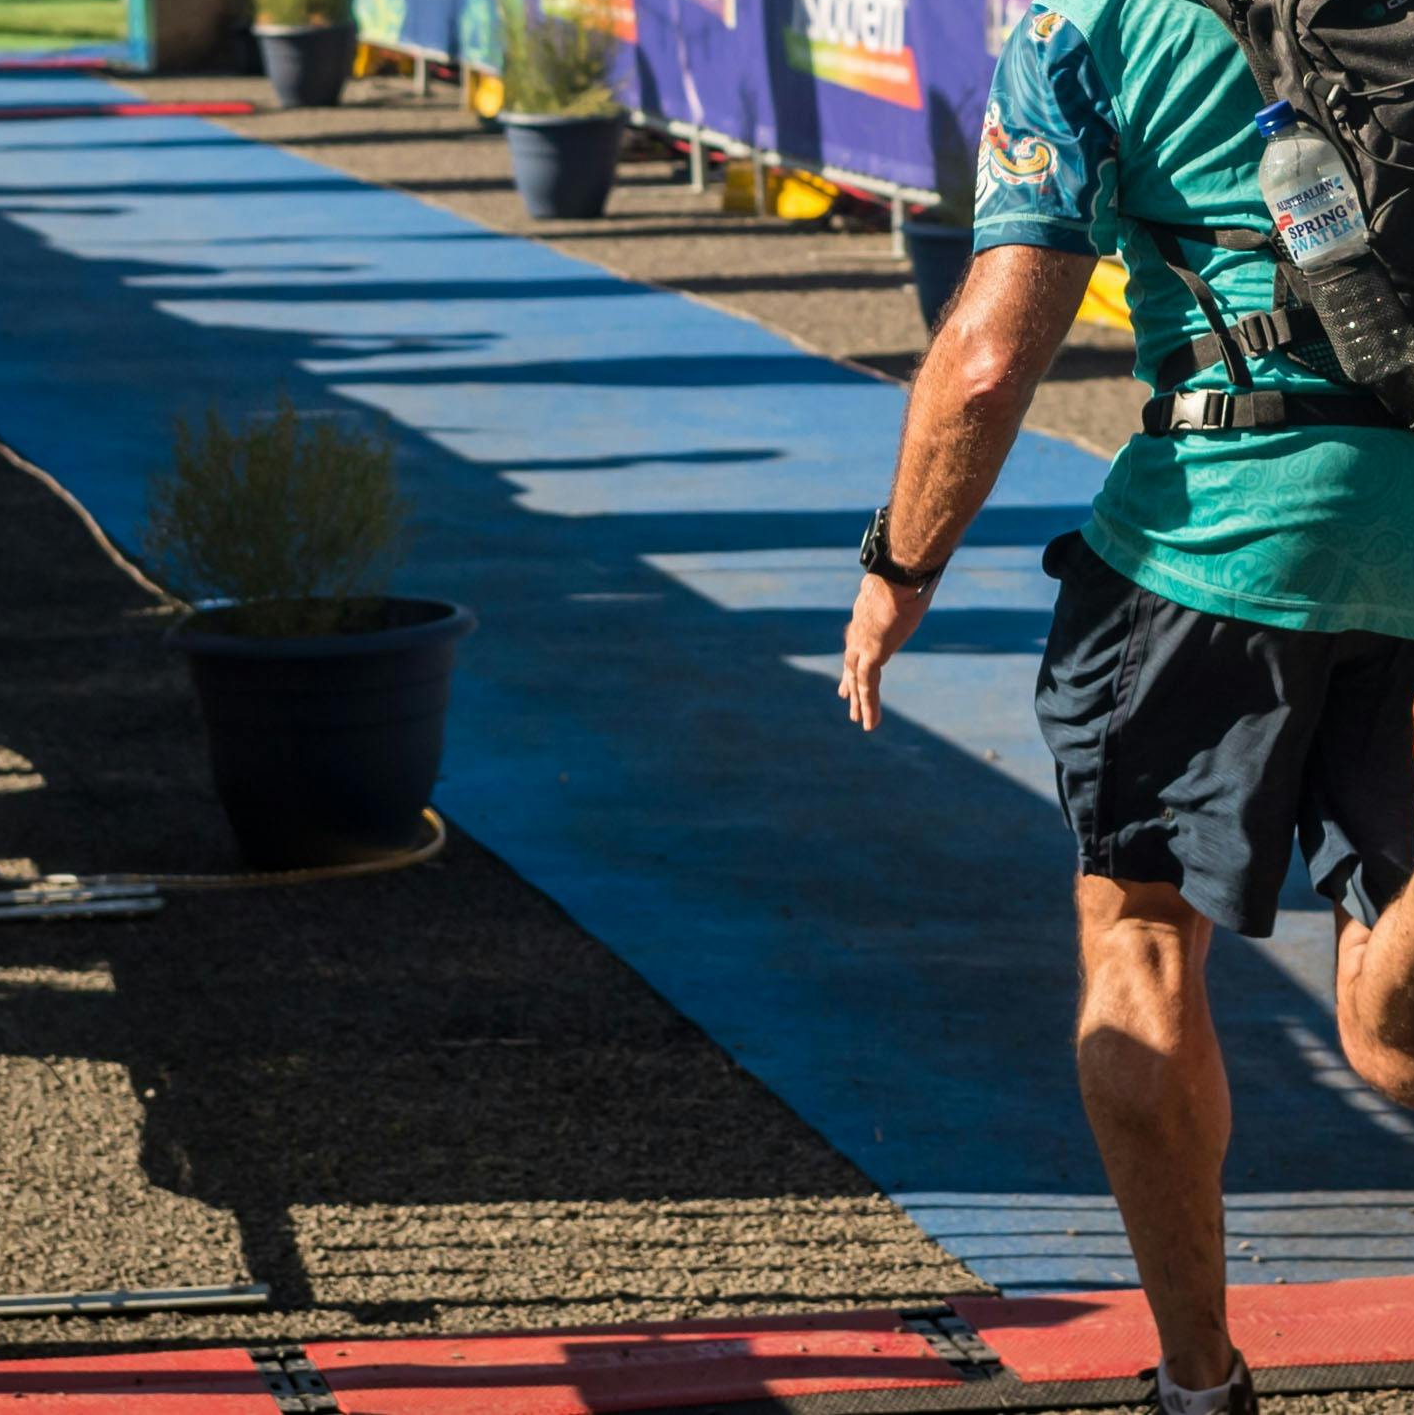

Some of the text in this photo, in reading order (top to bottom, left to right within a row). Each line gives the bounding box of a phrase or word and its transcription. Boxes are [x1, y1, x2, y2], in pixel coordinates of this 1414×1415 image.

[1276, 178, 1335, 212] AUSTRALIAN
[1288, 204, 1348, 241] SPRING
[1294, 218, 1354, 254] WATER
